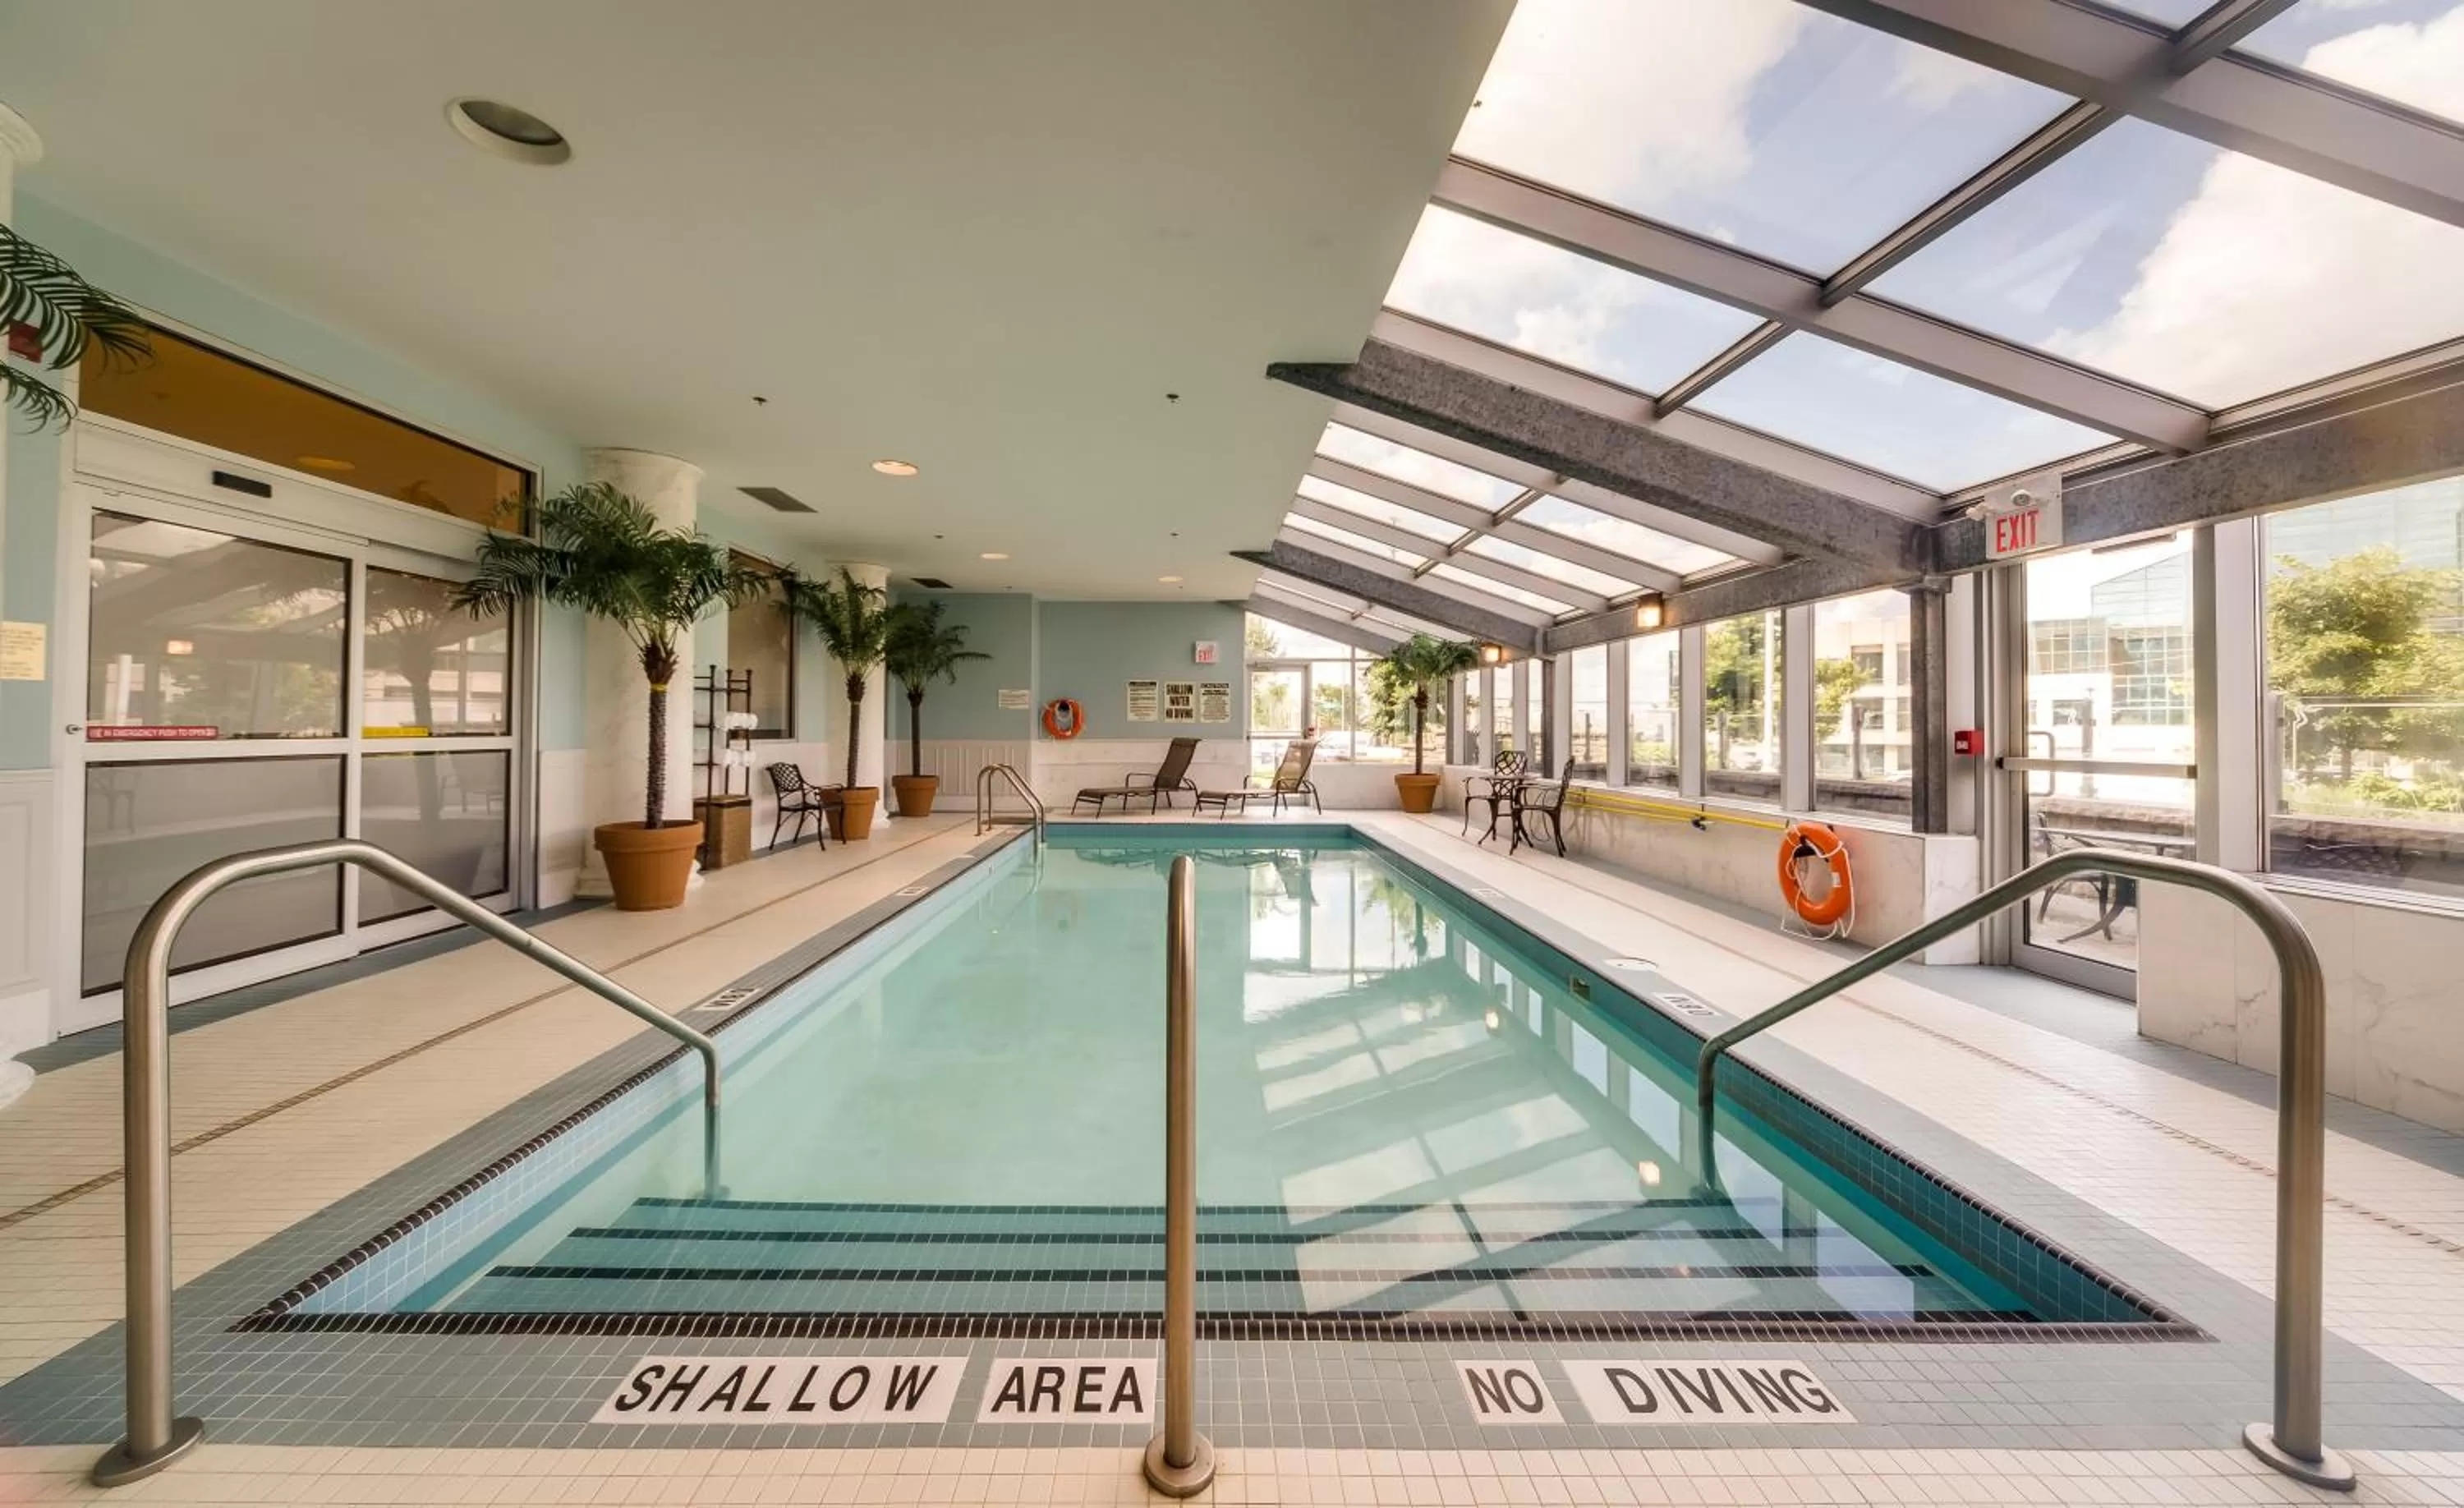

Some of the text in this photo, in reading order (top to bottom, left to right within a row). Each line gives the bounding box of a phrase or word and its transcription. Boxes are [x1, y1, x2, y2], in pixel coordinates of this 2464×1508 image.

[1997, 509, 2039, 553] EXIT
[1198, 648, 1214, 661] EXIT
[1166, 683, 1193, 695] SHALLOW
[1169, 696, 1190, 706] WATER
[1175, 707, 1193, 718] DIVING
[614, 1364, 1144, 1413] SHALLOW AREA
[1465, 1368, 1840, 1414] NO DIVING
